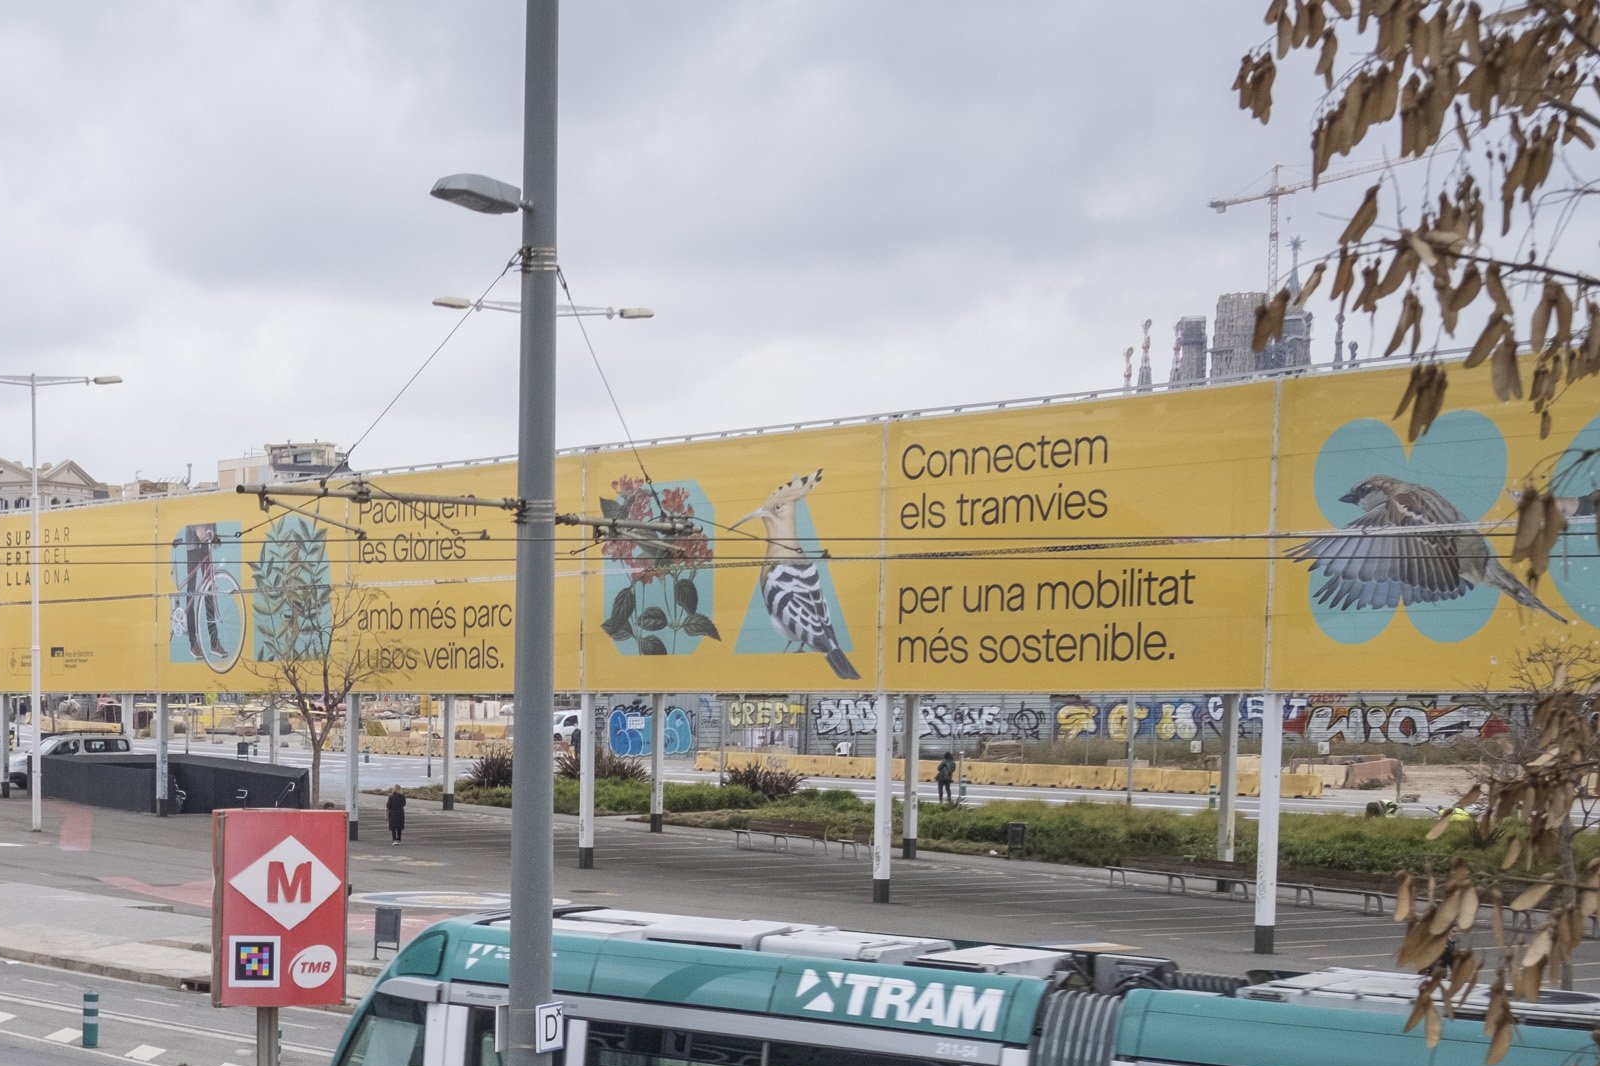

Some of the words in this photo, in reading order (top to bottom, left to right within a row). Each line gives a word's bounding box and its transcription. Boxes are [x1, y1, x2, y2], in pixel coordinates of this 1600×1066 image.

[901, 434, 1108, 480] Connectem
[900, 493, 946, 530] els
[956, 483, 1108, 527] tramvies
[6, 531, 31, 547] SUP
[44, 527, 71, 544] BAR
[359, 540, 387, 564] les
[393, 532, 466, 562] Glòries
[6, 572, 31, 587] LLA
[44, 569, 71, 586] ONA
[898, 586, 952, 624] per
[962, 582, 1025, 613] una
[1036, 568, 1195, 611] mobilitat
[357, 602, 403, 630] amb
[410, 600, 457, 630] més
[366, 646, 418, 670] usos
[424, 638, 505, 670] veïnals.
[897, 627, 969, 664] més
[979, 622, 1176, 664] sostenible.
[267, 861, 312, 904] M
[300, 961, 332, 974] TMB
[844, 973, 1005, 1032] TRAM
